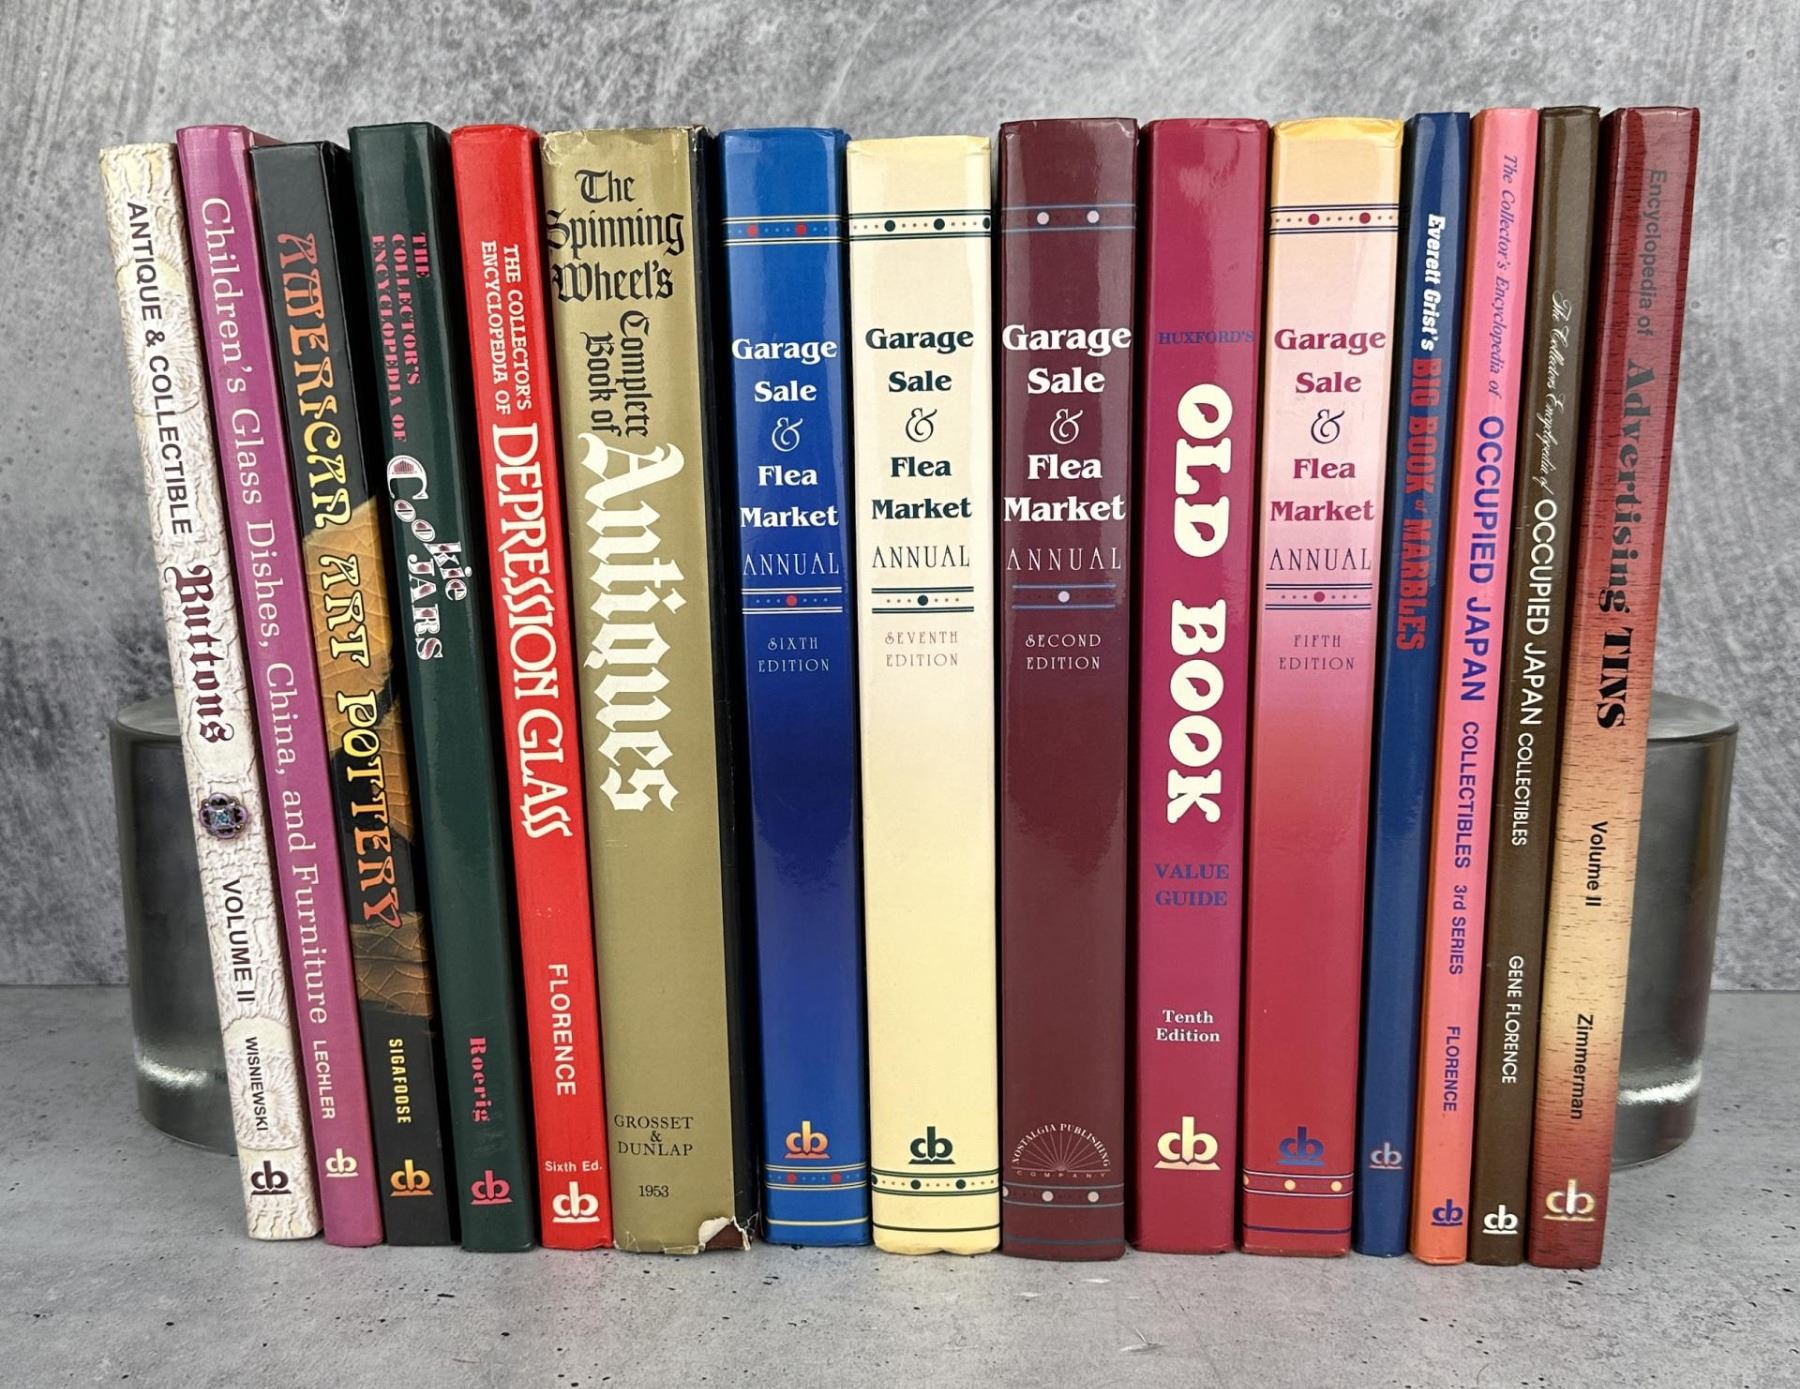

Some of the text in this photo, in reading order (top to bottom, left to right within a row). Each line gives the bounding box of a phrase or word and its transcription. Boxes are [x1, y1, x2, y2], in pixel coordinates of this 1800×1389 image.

[575, 169, 636, 204] The
[546, 209, 685, 259] Spinning
[412, 233, 431, 278] THE
[552, 261, 674, 302] Wheel's
[392, 234, 421, 385] COLLECTOR'S
[1551, 289, 1572, 322] The
[372, 235, 406, 442] ENCYCLOPEDIA OF
[481, 240, 511, 415] ENCYCLOPEDIA OF
[504, 245, 532, 410] THE COLLECTOR'S
[865, 329, 974, 351] Garage
[1002, 324, 1131, 357] Garage
[1158, 330, 1254, 345] HUXFORD'S
[1274, 329, 1386, 355] Garage
[127, 202, 192, 535] ANTIQUE & COLLECTIBLE
[732, 339, 838, 365] Garage
[580, 331, 621, 437] Book of
[620, 310, 653, 437] Complete
[888, 371, 952, 392] Sale
[1027, 367, 1105, 394] Sale
[1295, 372, 1362, 393] Sale
[754, 382, 817, 403] Sale
[771, 417, 803, 452] &
[905, 408, 937, 442] &
[1050, 409, 1083, 445] &
[1310, 409, 1345, 444] &
[1396, 213, 1446, 651] Everett Grist's BIG BOOK of MARBLES
[1536, 393, 1565, 474] Encyclopedia
[1596, 169, 1667, 729] Encyclopedia of Advertising TINS
[758, 465, 818, 486] Flea
[891, 457, 952, 477] Flea
[1027, 455, 1102, 479] Flea
[1293, 458, 1356, 479] Flea
[1532, 476, 1554, 495] of
[740, 506, 839, 528] Market
[871, 497, 972, 519] Market
[1004, 495, 1125, 522] Market
[1271, 500, 1375, 522] Market
[387, 455, 472, 600] Cookie
[743, 552, 839, 576] ANNUAL
[872, 546, 970, 568] ANNUAL
[1007, 547, 1121, 571] ANNUAL
[1269, 547, 1371, 571] ANNUAL
[1449, 154, 1517, 975] The Collector's Encyclopedia of OCCUPIED JAPAN COLLECTIBLES 3rd SERIES
[1525, 499, 1558, 636] OCCUPIED
[277, 232, 403, 928] AMERICAN ART POTTERY
[202, 198, 328, 1024] Children's Glass Dishes, China, and Furniture
[407, 554, 443, 660] JARS
[1167, 383, 1233, 824] OLD BOOK
[492, 423, 574, 839] DEPRESSION GLASS
[577, 432, 687, 812] Antiques
[885, 631, 958, 645] SEVENTH
[164, 564, 234, 743] Buttons
[767, 637, 818, 650] SIXTH
[1025, 634, 1101, 648] SECOND
[1294, 634, 1341, 648] FIFTH
[758, 659, 829, 672] EDITION
[886, 653, 959, 667] EDITION
[1026, 656, 1100, 670] EDITION
[1279, 656, 1355, 670] EDITION
[1519, 643, 1548, 725] JAPAN
[1512, 732, 1534, 847] COLLECTIBLES
[1154, 864, 1229, 880] VALUE
[1585, 821, 1608, 907] Volume II
[1154, 891, 1227, 906] GUIDE
[222, 879, 255, 1003] VOLUME II
[548, 963, 576, 1096] FLORENCE
[1162, 1010, 1214, 1025] Tenth
[1502, 956, 1524, 1084] GENE FLORENCE
[1156, 1028, 1221, 1043] Edition
[312, 1040, 336, 1120] LECHLER
[389, 1038, 411, 1124] SIGAFOOSE
[469, 1036, 492, 1123] Roerig
[1443, 1026, 1460, 1112] FLORENCE
[1570, 1012, 1594, 1120] Zimmerman
[245, 1036, 268, 1131] WISNIEWSKI
[614, 1114, 694, 1130] GROSSET
[650, 1131, 662, 1143] &
[617, 1142, 693, 1157] DUNLAP
[1011, 1123, 1111, 1167] NOSTALGIA PUBLISHING
[545, 1160, 602, 1173] Sixth Ed.
[1016, 1170, 1106, 1179] COMPANY
[638, 1185, 669, 1198] 1953
